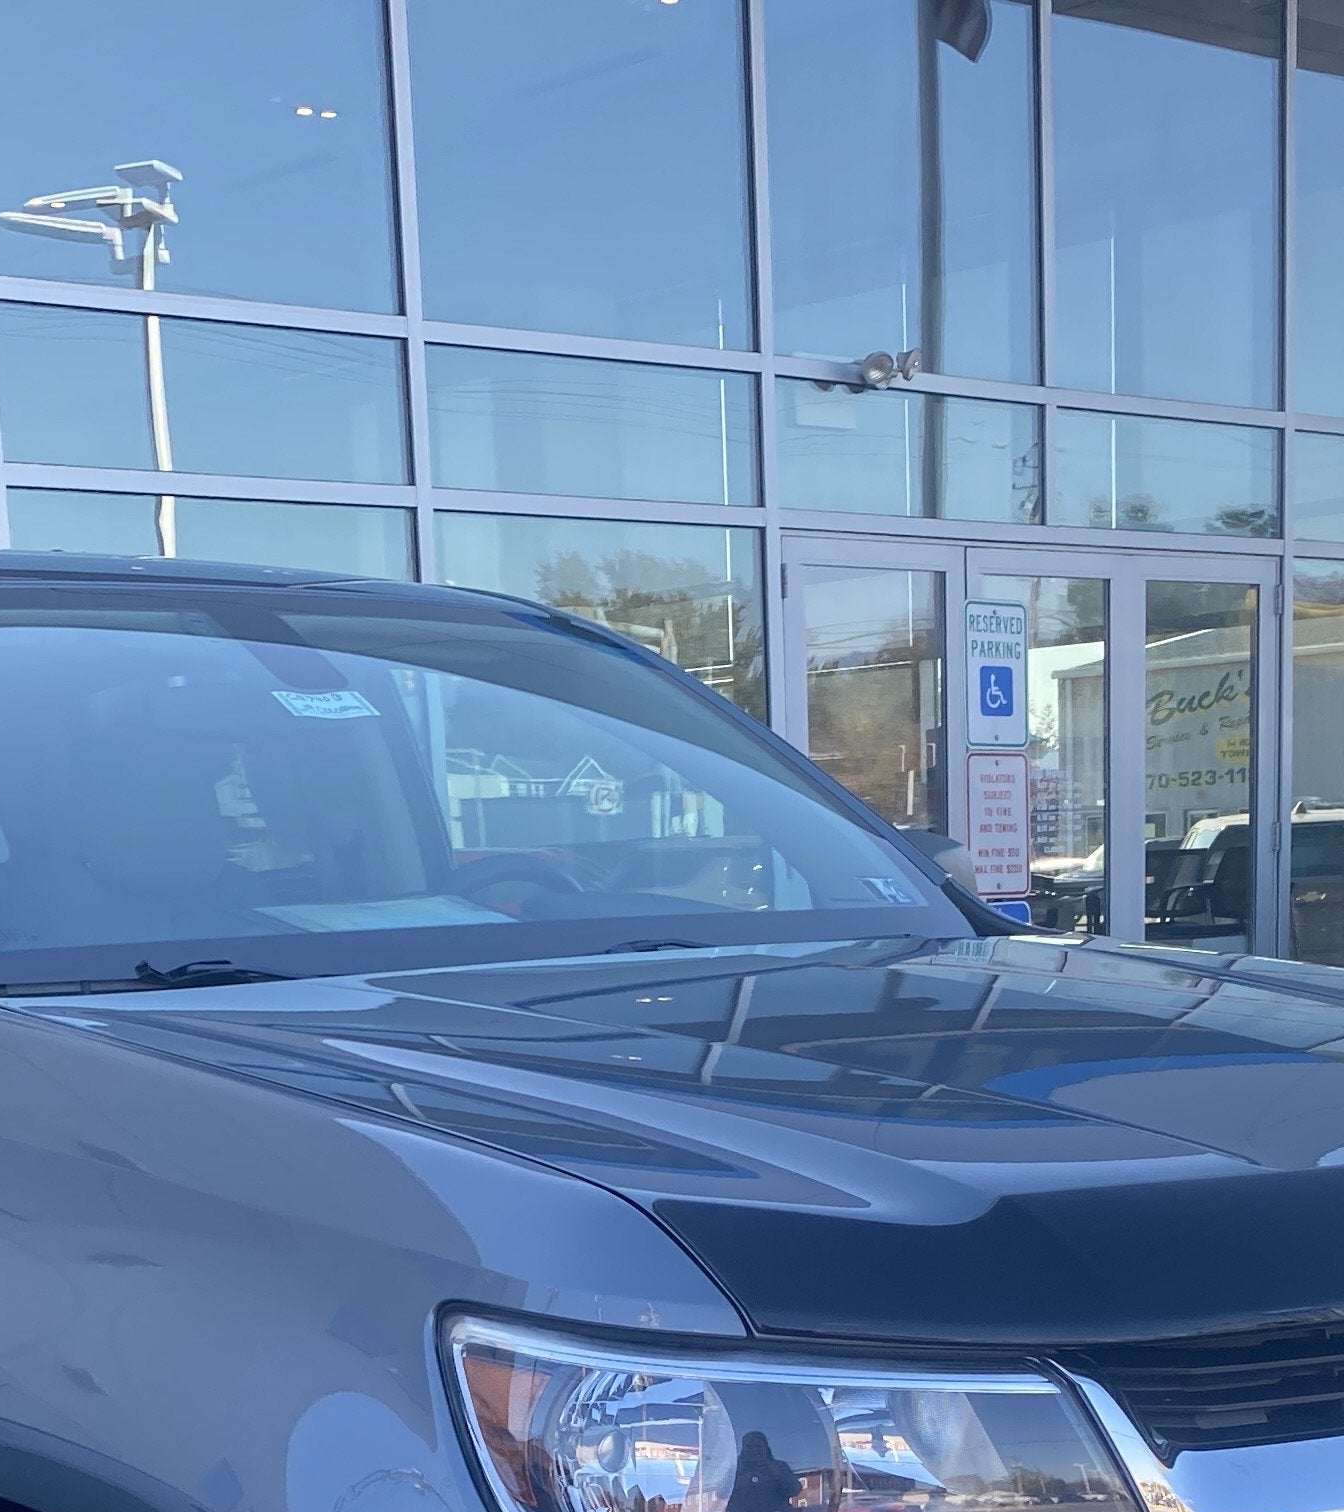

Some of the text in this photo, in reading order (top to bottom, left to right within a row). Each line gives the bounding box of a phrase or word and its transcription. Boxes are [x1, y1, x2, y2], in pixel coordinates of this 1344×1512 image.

[968, 613, 1023, 635] RESERVED
[971, 639, 1022, 660] PARKING
[1145, 669, 1251, 726] Buck'
[1146, 767, 1249, 790] 70-523-11
[984, 807, 1013, 817] TO FINE
[979, 823, 1018, 834] AND TOWING
